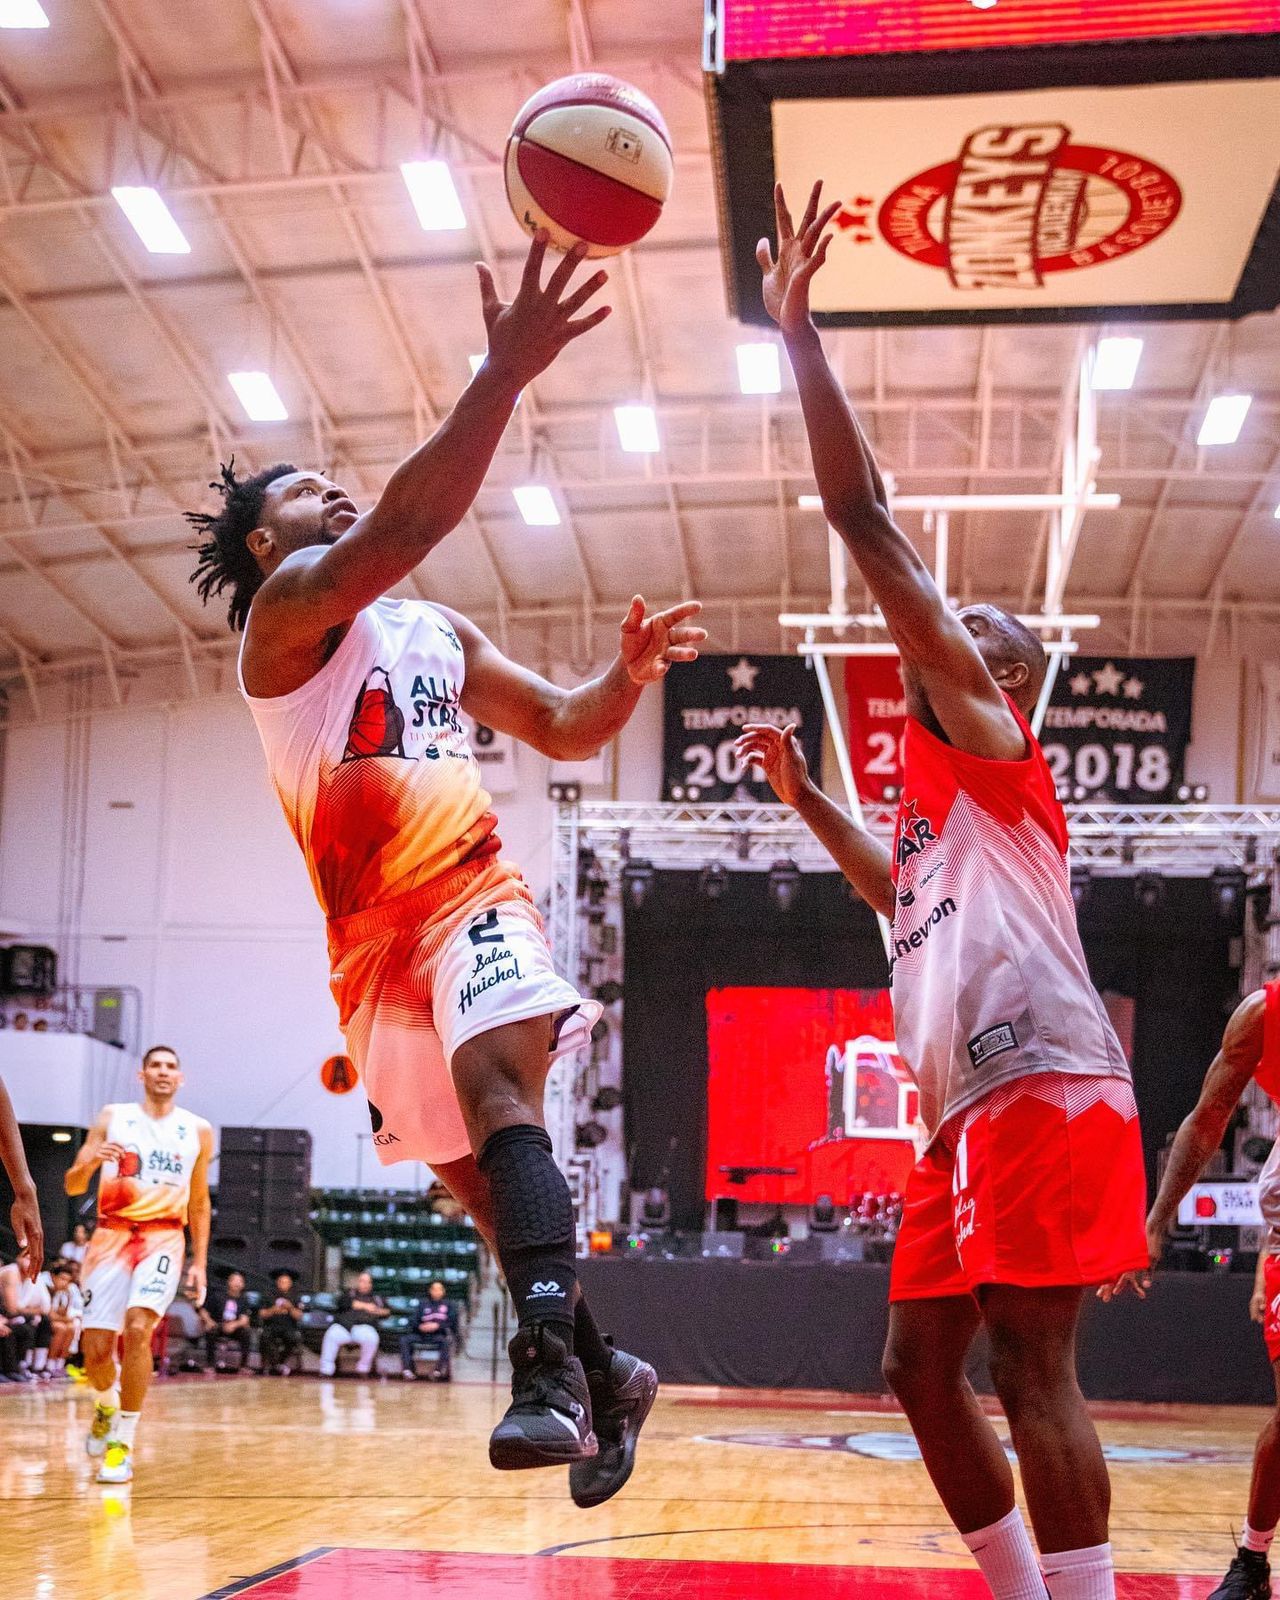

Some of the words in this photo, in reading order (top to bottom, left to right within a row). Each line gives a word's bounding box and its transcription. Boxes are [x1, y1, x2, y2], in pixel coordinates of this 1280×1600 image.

[949, 126, 1067, 289] ZONKEYS
[1070, 153, 1176, 267] BASQUETBOL
[410, 675, 453, 704] ALL
[1044, 706, 1167, 733] TEMPORADA
[1042, 743, 1171, 792] 2018
[468, 907, 505, 947] 2
[471, 947, 513, 979] Salsa
[457, 957, 523, 1016] Huichol
[996, 1031, 1011, 1044] XL
[330, 1056, 350, 1089] A
[148, 1159, 184, 1175] STAR
[157, 1255, 170, 1275] 0
